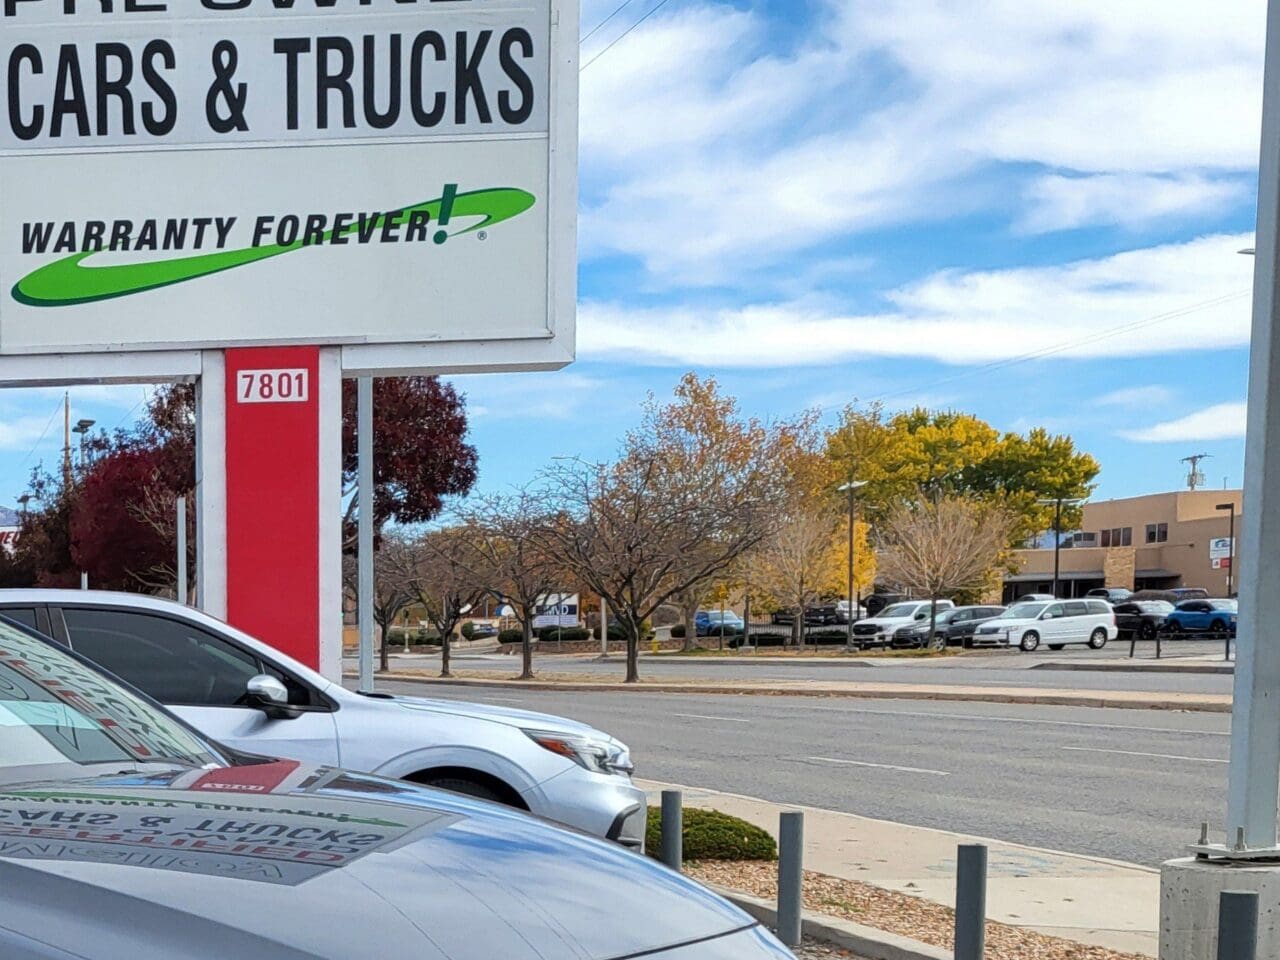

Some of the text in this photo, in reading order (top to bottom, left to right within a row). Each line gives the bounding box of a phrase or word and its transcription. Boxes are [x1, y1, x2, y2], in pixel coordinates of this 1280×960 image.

[8, 26, 534, 141] CARS & TRUCKS
[21, 183, 458, 255] WARRANTY FOREVER!
[241, 372, 304, 399] 7801
